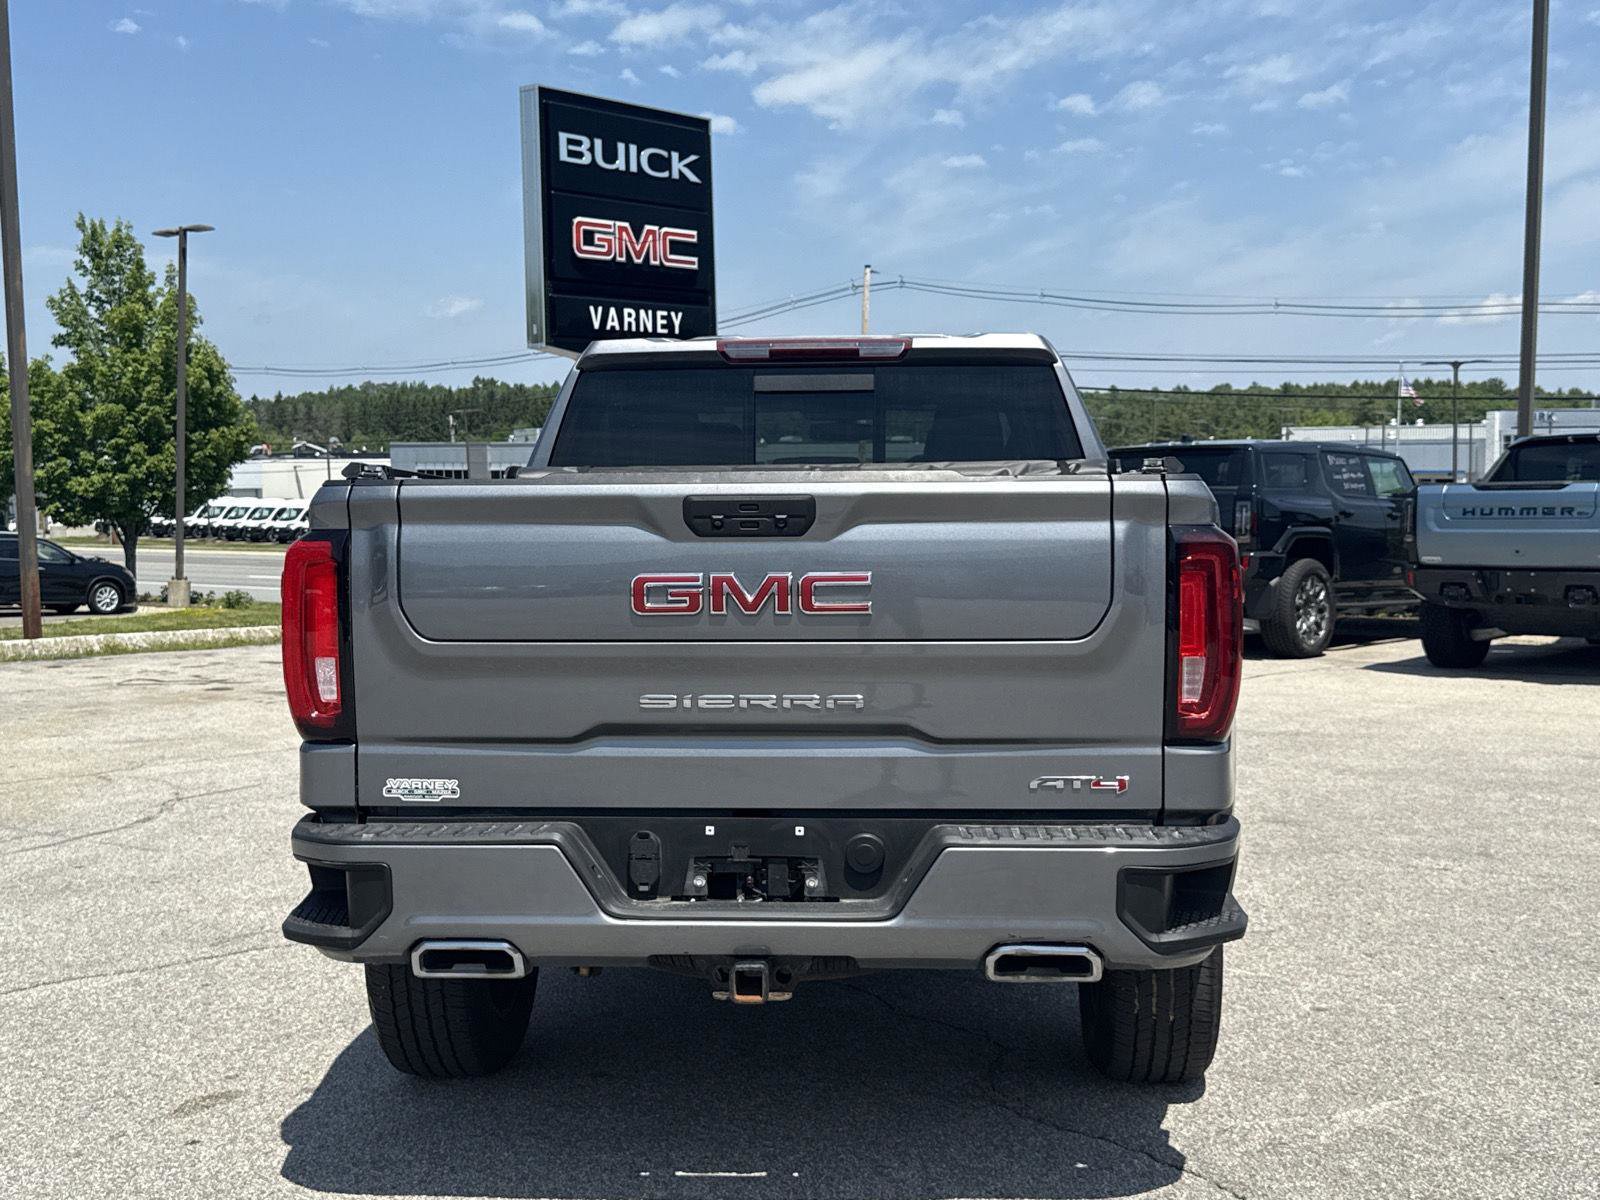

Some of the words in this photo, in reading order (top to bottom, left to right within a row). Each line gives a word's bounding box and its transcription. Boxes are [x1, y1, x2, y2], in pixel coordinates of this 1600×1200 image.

[558, 131, 702, 184] BUICK
[572, 216, 699, 270] GMC
[589, 305, 683, 335] VARNEY
[1462, 506, 1577, 517] HUMMER
[631, 571, 872, 615] GMC
[639, 693, 864, 709] SIERRA
[387, 779, 458, 789] VARNEY
[1029, 775, 1130, 794] AT4
